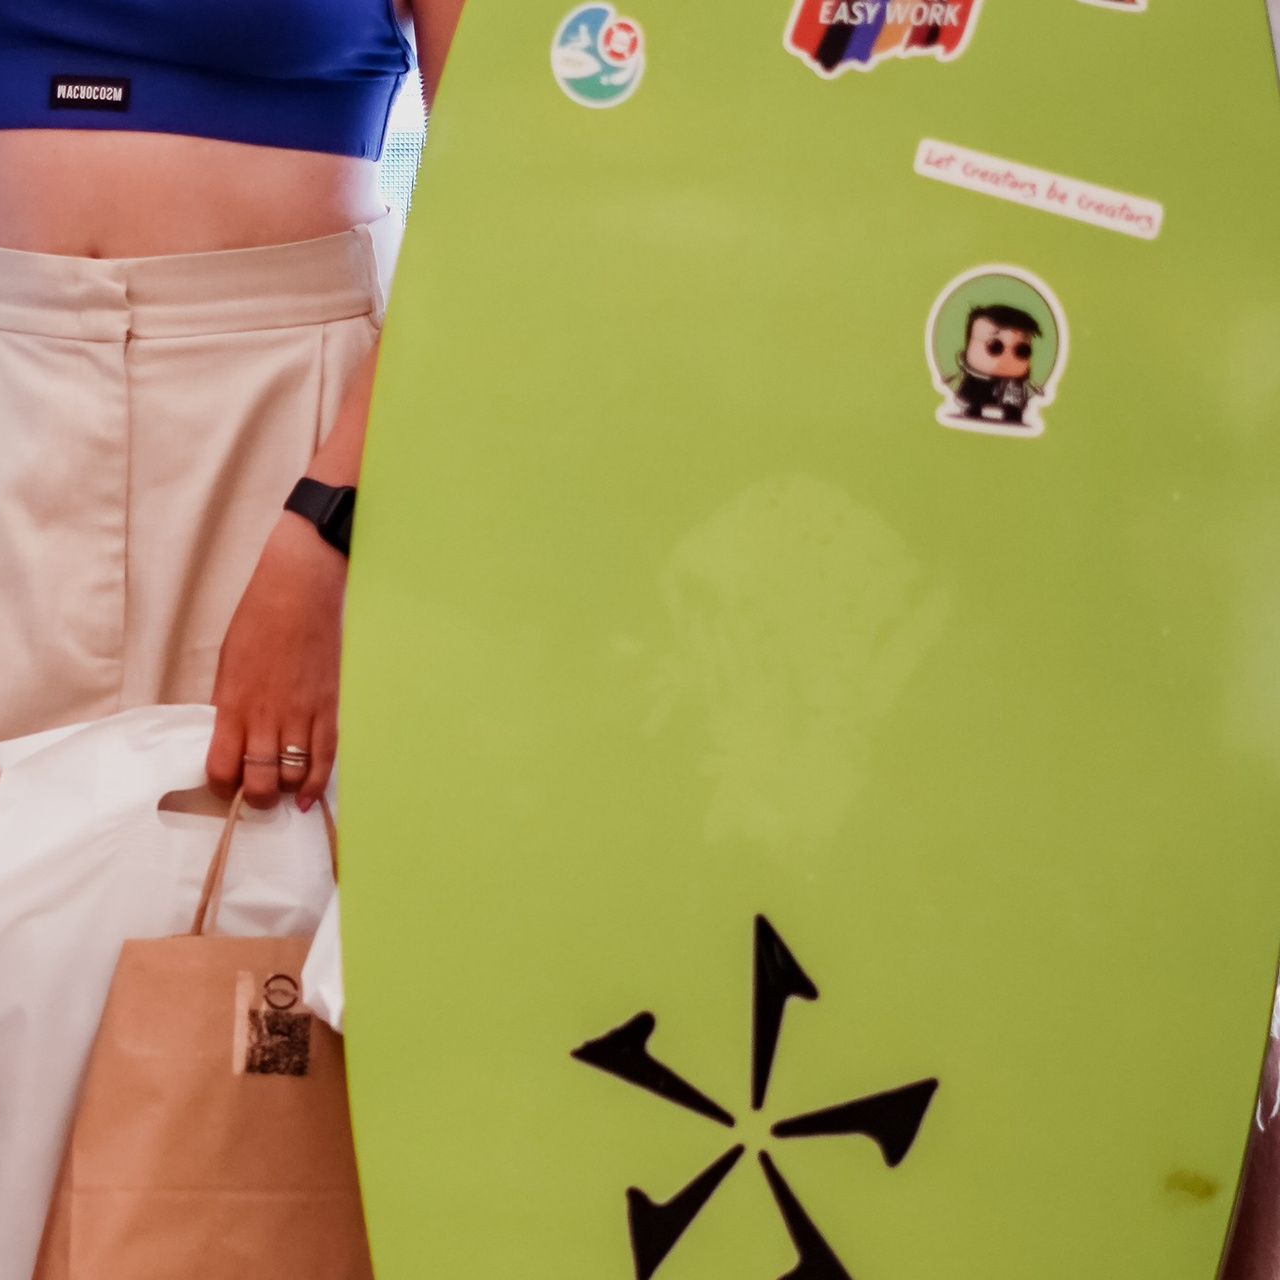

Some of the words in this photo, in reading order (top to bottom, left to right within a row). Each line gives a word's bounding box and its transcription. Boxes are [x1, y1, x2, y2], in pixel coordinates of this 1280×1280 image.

[818, 1, 881, 25] EASY
[885, 2, 962, 27] WORK
[1045, 180, 1068, 204] be
